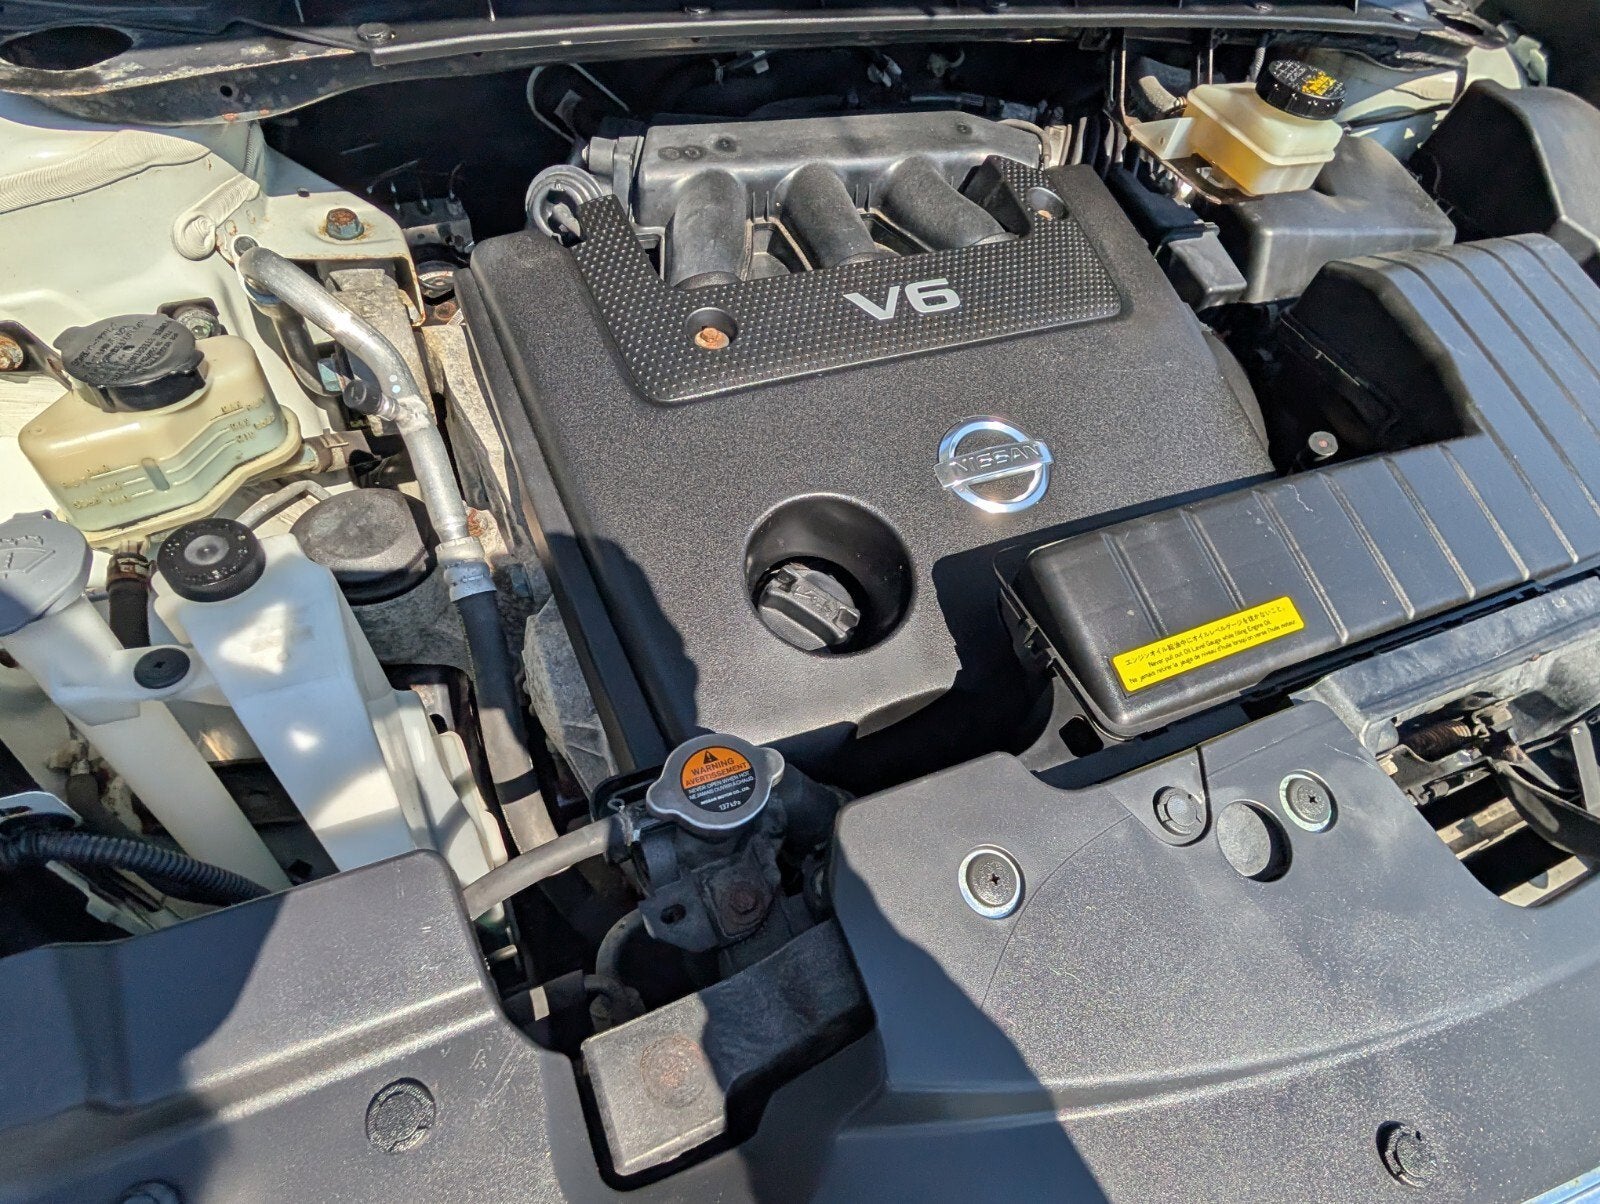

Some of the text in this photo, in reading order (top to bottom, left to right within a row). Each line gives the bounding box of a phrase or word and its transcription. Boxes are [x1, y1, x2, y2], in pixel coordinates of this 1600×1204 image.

[843, 278, 960, 320] V6
[951, 445, 1041, 472] NISSAN
[1148, 658, 1164, 667] Never
[1165, 654, 1174, 663] pull
[1191, 643, 1205, 653] Level
[1206, 638, 1221, 649] Gauge
[1222, 634, 1234, 643] while
[1235, 628, 1247, 638] filling
[1247, 623, 1262, 633] Engine
[1263, 619, 1271, 627] Oil
[1194, 653, 1201, 661] de
[686, 763, 747, 786] AVERTISSEMENT
[691, 758, 734, 775] WARNING
[688, 785, 706, 793] NEVER
[707, 780, 722, 788] OPEN
[722, 774, 739, 785] WHEN
